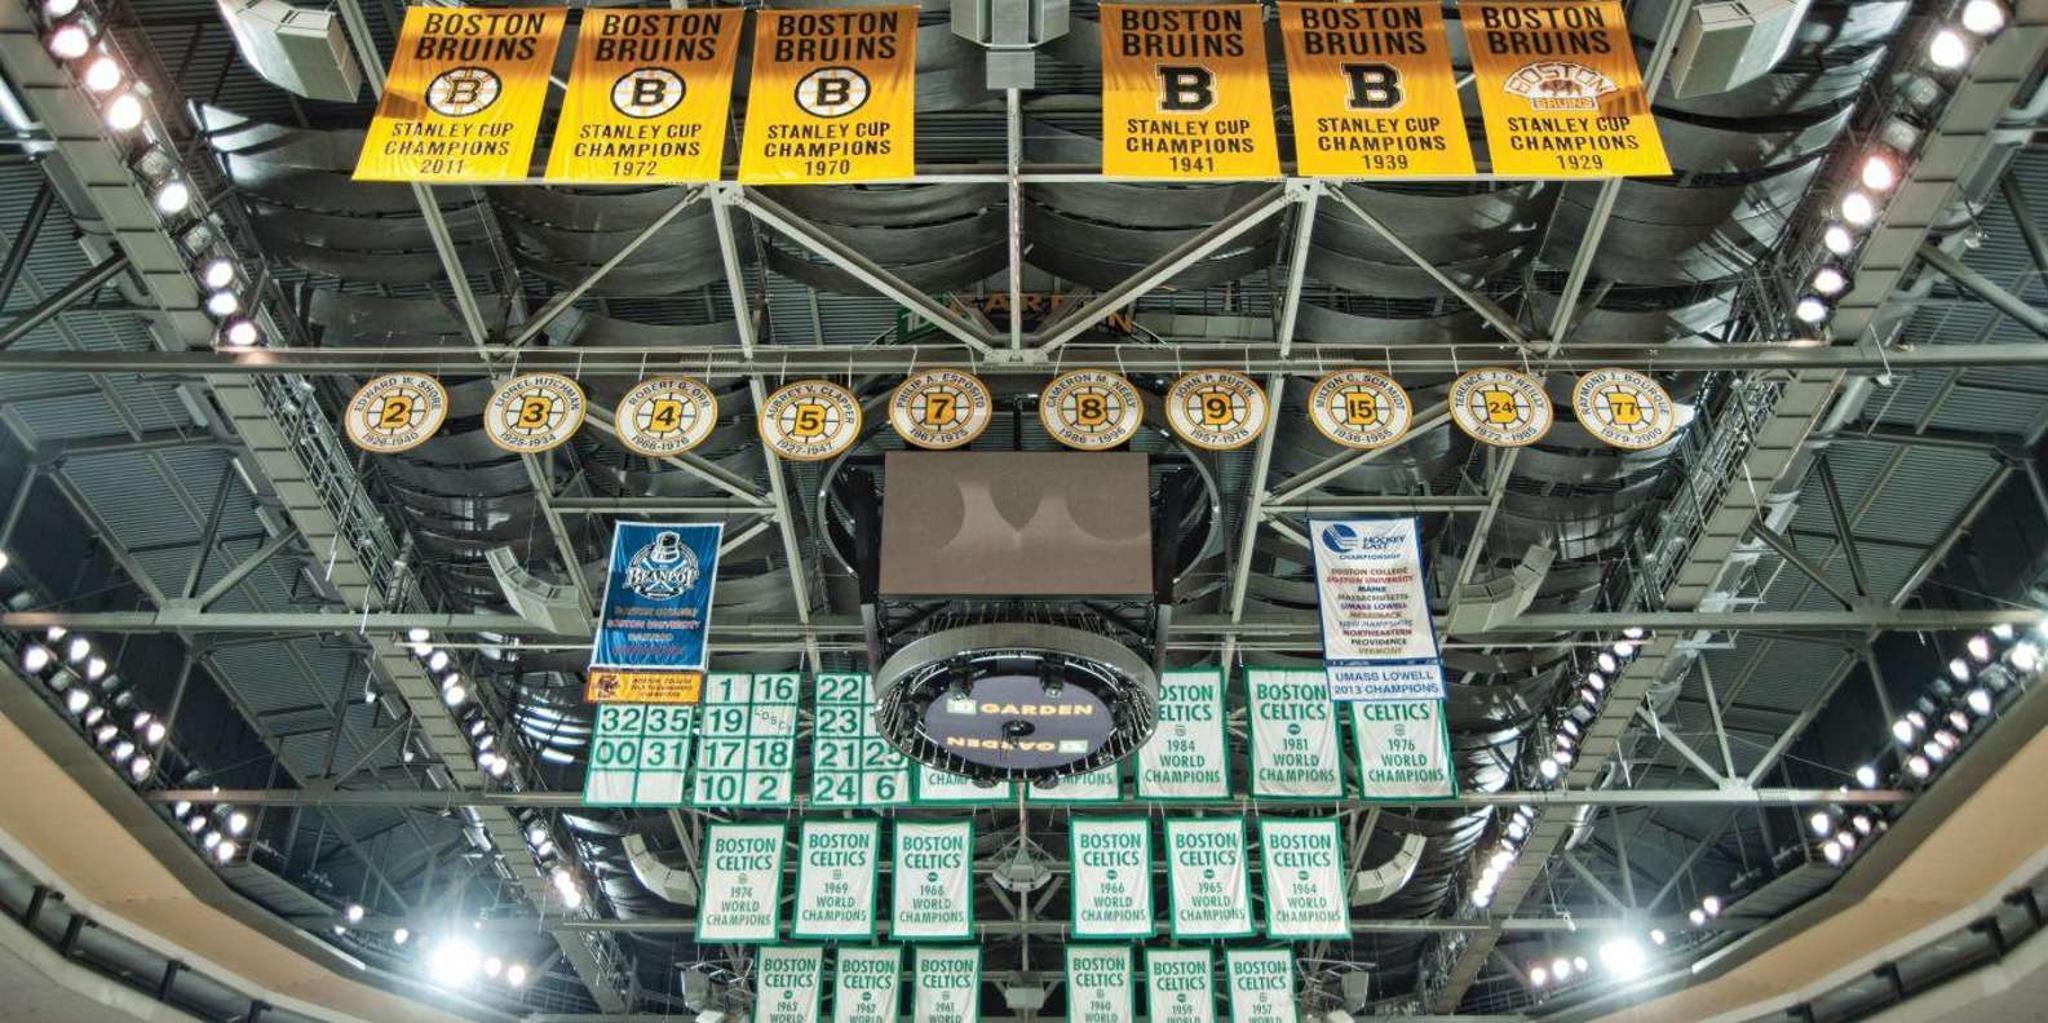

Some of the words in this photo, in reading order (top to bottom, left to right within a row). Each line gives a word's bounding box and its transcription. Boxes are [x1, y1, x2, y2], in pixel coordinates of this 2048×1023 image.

[424, 13, 546, 36] BOSTON
[602, 14, 724, 37] BOSTON
[777, 13, 898, 37] BOSTON
[1121, 10, 1243, 32] BOSTON
[1302, 7, 1424, 31] BOSTON
[1483, 6, 1604, 29] BOSTON
[415, 37, 537, 62] BRUINS
[594, 37, 717, 63] BRUINS
[775, 37, 897, 63] BRUINS
[1122, 32, 1244, 57] BRUINS
[1304, 31, 1426, 55] BRUINS
[1488, 29, 1611, 55] BRUINS
[1344, 64, 1403, 110] B
[1503, 62, 1619, 96] BOSTON
[448, 79, 481, 104] B
[631, 77, 665, 106] B
[817, 78, 850, 105] B
[1159, 65, 1215, 110] B
[392, 122, 473, 139] STANLEY
[478, 122, 514, 138] CUP
[580, 123, 664, 139] STANLEY
[670, 123, 702, 139] CUP
[768, 122, 850, 139] STANLEY
[855, 122, 890, 138] CUP
[1127, 119, 1209, 136] STANLEY
[1216, 120, 1250, 135] CUP
[1317, 117, 1399, 135] STANLEY
[1405, 117, 1440, 133] CUP
[1508, 117, 1590, 134] STANLEY
[1596, 116, 1631, 132] CUP
[384, 140, 510, 157] CHAMPIONS
[573, 141, 700, 157] CHAMPIONS
[763, 140, 891, 157] CHAMPIONS
[1126, 136, 1254, 154] CHAMPIONS
[1318, 135, 1446, 153] CHAMPIONS
[1510, 134, 1638, 152] CHAMPIONS
[420, 159, 464, 175] 2011
[613, 161, 658, 176] 1972
[804, 160, 850, 175] 1970
[1170, 157, 1214, 173] 1941
[1363, 155, 1408, 171] 1939
[1556, 154, 1603, 171] 1929
[1047, 374, 1093, 408] CAMERON
[1176, 377, 1201, 400] JOHN
[384, 402, 406, 424] 2
[524, 403, 544, 423] 3
[931, 398, 950, 419] 7
[1081, 399, 1101, 419] 8
[1206, 398, 1227, 419] 9
[1349, 400, 1373, 418] 15
[1490, 402, 1513, 413] 24
[1615, 402, 1636, 415] 77
[656, 406, 676, 427] 4
[799, 410, 823, 431] 5
[1363, 534, 1405, 544] HOCKEY
[1335, 671, 1379, 682] UMASS
[1383, 670, 1433, 681] LOWELL
[720, 677, 732, 701] 1
[762, 678, 792, 700] 16
[820, 678, 859, 700] 22
[1158, 685, 1213, 701] OSTON
[1257, 683, 1325, 700] BOSTON
[1335, 684, 1361, 694] 2013
[1364, 683, 1438, 694] CHAMPIONS
[981, 704, 1093, 715] GARDEN
[1158, 704, 1212, 721] ELTICS
[1260, 703, 1325, 720] CELTICS
[1364, 703, 1430, 720] CELTICS
[601, 708, 640, 732] 32
[649, 708, 689, 732] 35
[711, 709, 742, 732] 19
[819, 709, 857, 732] 23
[1168, 740, 1195, 751] 1984
[1284, 738, 1309, 750] 1981
[1388, 739, 1415, 751] 1976
[594, 741, 635, 764] 00
[648, 742, 683, 766] 31
[704, 742, 740, 766] 17
[754, 742, 788, 766] 18
[820, 743, 852, 767] 21
[1160, 755, 1205, 766] WORLD
[1273, 754, 1319, 766] WORLD
[1382, 754, 1427, 766] WORLD
[1145, 770, 1219, 783] CHAMPIONS
[1259, 769, 1334, 782] CHAMPIONS
[1368, 769, 1444, 782] CHAMPIONS
[701, 776, 736, 800] 10
[758, 776, 777, 800] 2
[816, 776, 856, 800] 24
[877, 776, 896, 799] 6
[715, 838, 776, 853] BOSTON
[809, 834, 869, 849] BOSTON
[903, 836, 963, 851] BOSTON
[1081, 833, 1141, 848] BOSTON
[1176, 833, 1237, 848] BOSTON
[1270, 834, 1331, 850] BOSTON
[716, 855, 772, 870] CELTICS
[810, 851, 866, 866] CELTICS
[904, 853, 960, 869] CELTICS
[1084, 851, 1140, 866] CELTICS
[1179, 851, 1236, 866] CELTICS
[1274, 852, 1331, 868] CELTICS
[825, 883, 848, 894] 1969
[1101, 883, 1125, 894] 1966
[1199, 883, 1222, 893] 1965
[1293, 883, 1316, 894] 1964
[721, 901, 760, 912] WORLD
[816, 897, 855, 908] WORLD
[912, 899, 951, 909] WORLD
[1094, 897, 1132, 907] WORLD
[1192, 896, 1231, 907] WORLD
[1287, 897, 1326, 908] WORLD
[706, 914, 770, 925] CHAMPIONS
[802, 910, 866, 922] CHAMPIONS
[900, 911, 964, 923] CHAMPIONS
[1081, 910, 1146, 921] CHAMPIONS
[1181, 909, 1245, 920] CHAMPIONS
[1277, 910, 1341, 922] CHAMPIONS
[764, 958, 816, 972] BOSTON
[842, 960, 894, 974] BOSTON
[921, 959, 973, 973] BOSTON
[1073, 957, 1124, 971] BOSTON
[1154, 961, 1205, 975] BOSTON
[1235, 960, 1286, 974] BOSTON
[765, 974, 813, 988] CELTICS
[843, 975, 891, 989] CELTICS
[922, 974, 970, 988] CELTICS
[1076, 973, 1123, 986] CELTICS
[1157, 977, 1205, 991] CELTICS
[1238, 976, 1286, 991] CELTICS
[1252, 1004, 1272, 1014] 1957
